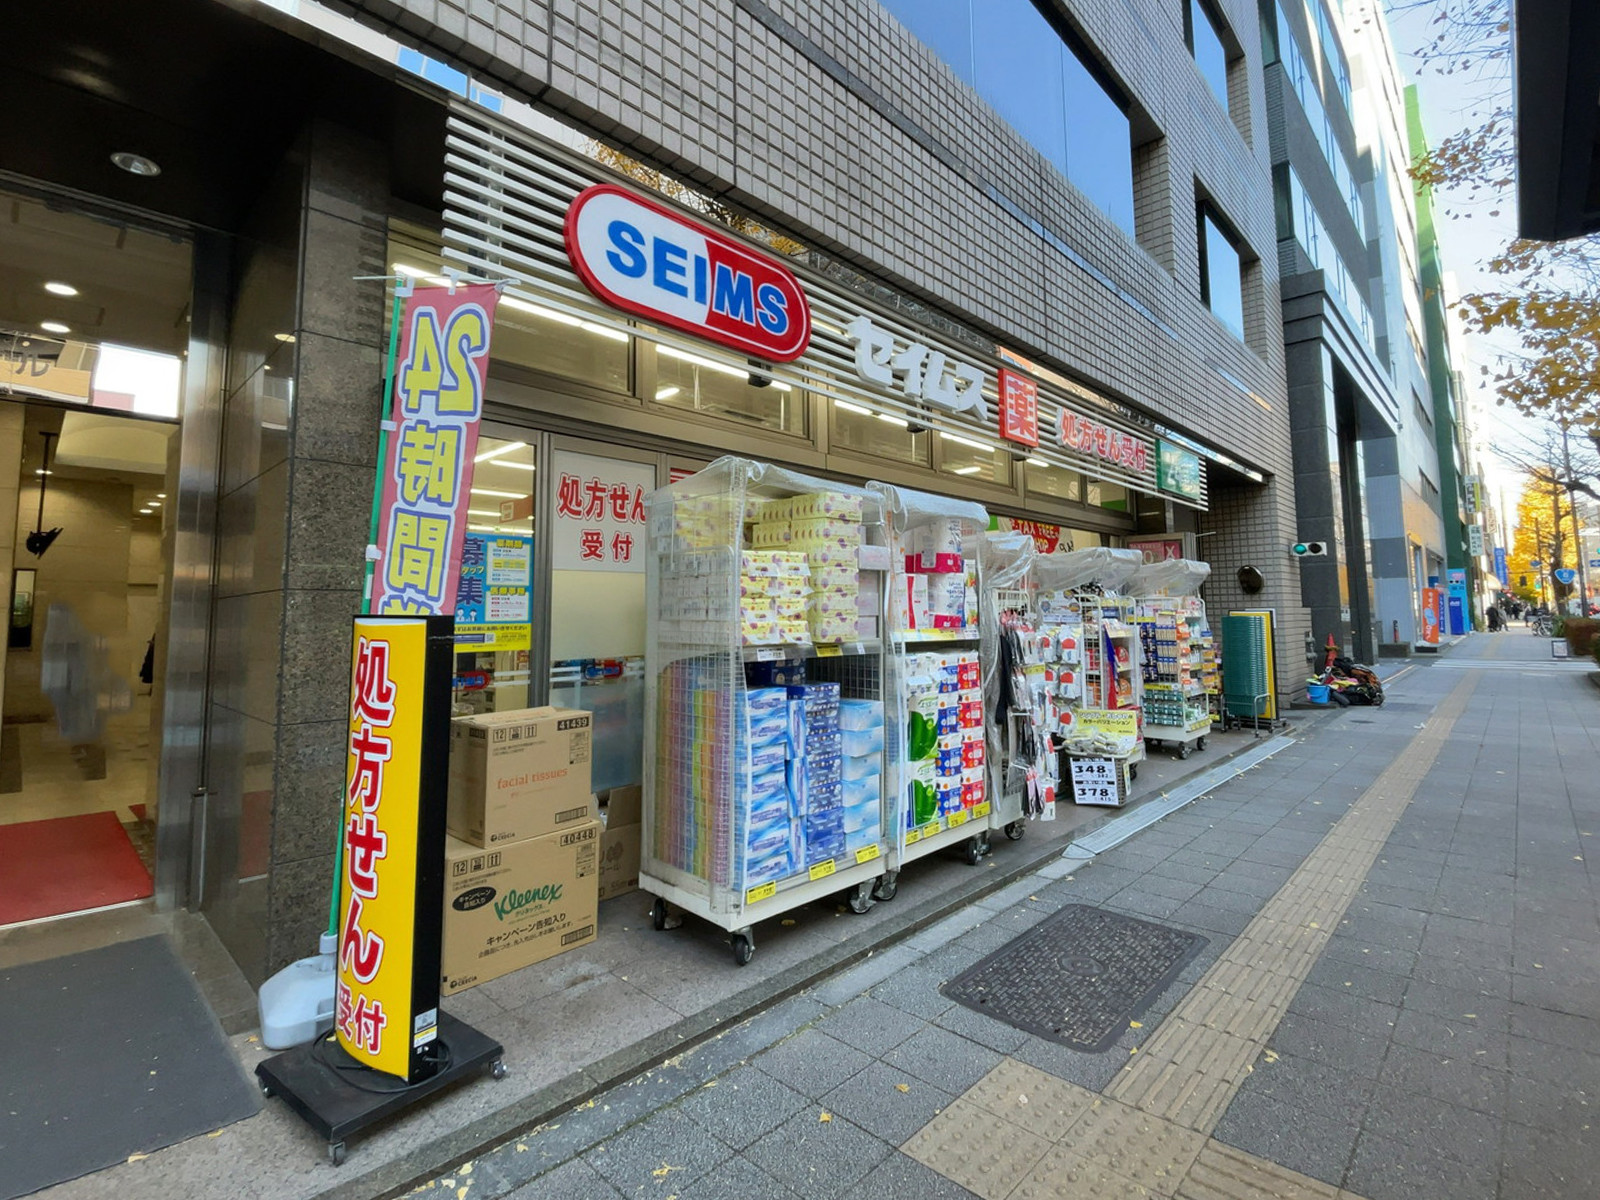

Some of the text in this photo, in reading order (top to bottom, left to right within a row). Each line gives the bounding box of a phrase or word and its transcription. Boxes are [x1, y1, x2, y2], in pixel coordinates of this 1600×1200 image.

[605, 219, 789, 337] SEIMS
[847, 316, 988, 421] セイムス
[1006, 376, 1037, 441] 薬
[1060, 406, 1146, 472] 処方せん受付
[558, 472, 647, 523] 処方せん
[1017, 519, 1055, 538] TAX FREE
[581, 529, 634, 562] 受付
[1033, 537, 1049, 551] HOP
[494, 728, 505, 741] 12
[559, 717, 589, 731] 41439
[497, 767, 568, 790] facial tissues
[1074, 765, 1106, 774] 348
[1077, 788, 1109, 797] 378
[342, 637, 397, 985] 処方せん
[562, 828, 594, 845] 40448
[454, 861, 466, 874] 12
[458, 888, 492, 902] キャンペーン
[493, 883, 564, 921] Kleenex
[486, 912, 567, 946] キャンペーン告知入り
[337, 980, 387, 1056] 受付
